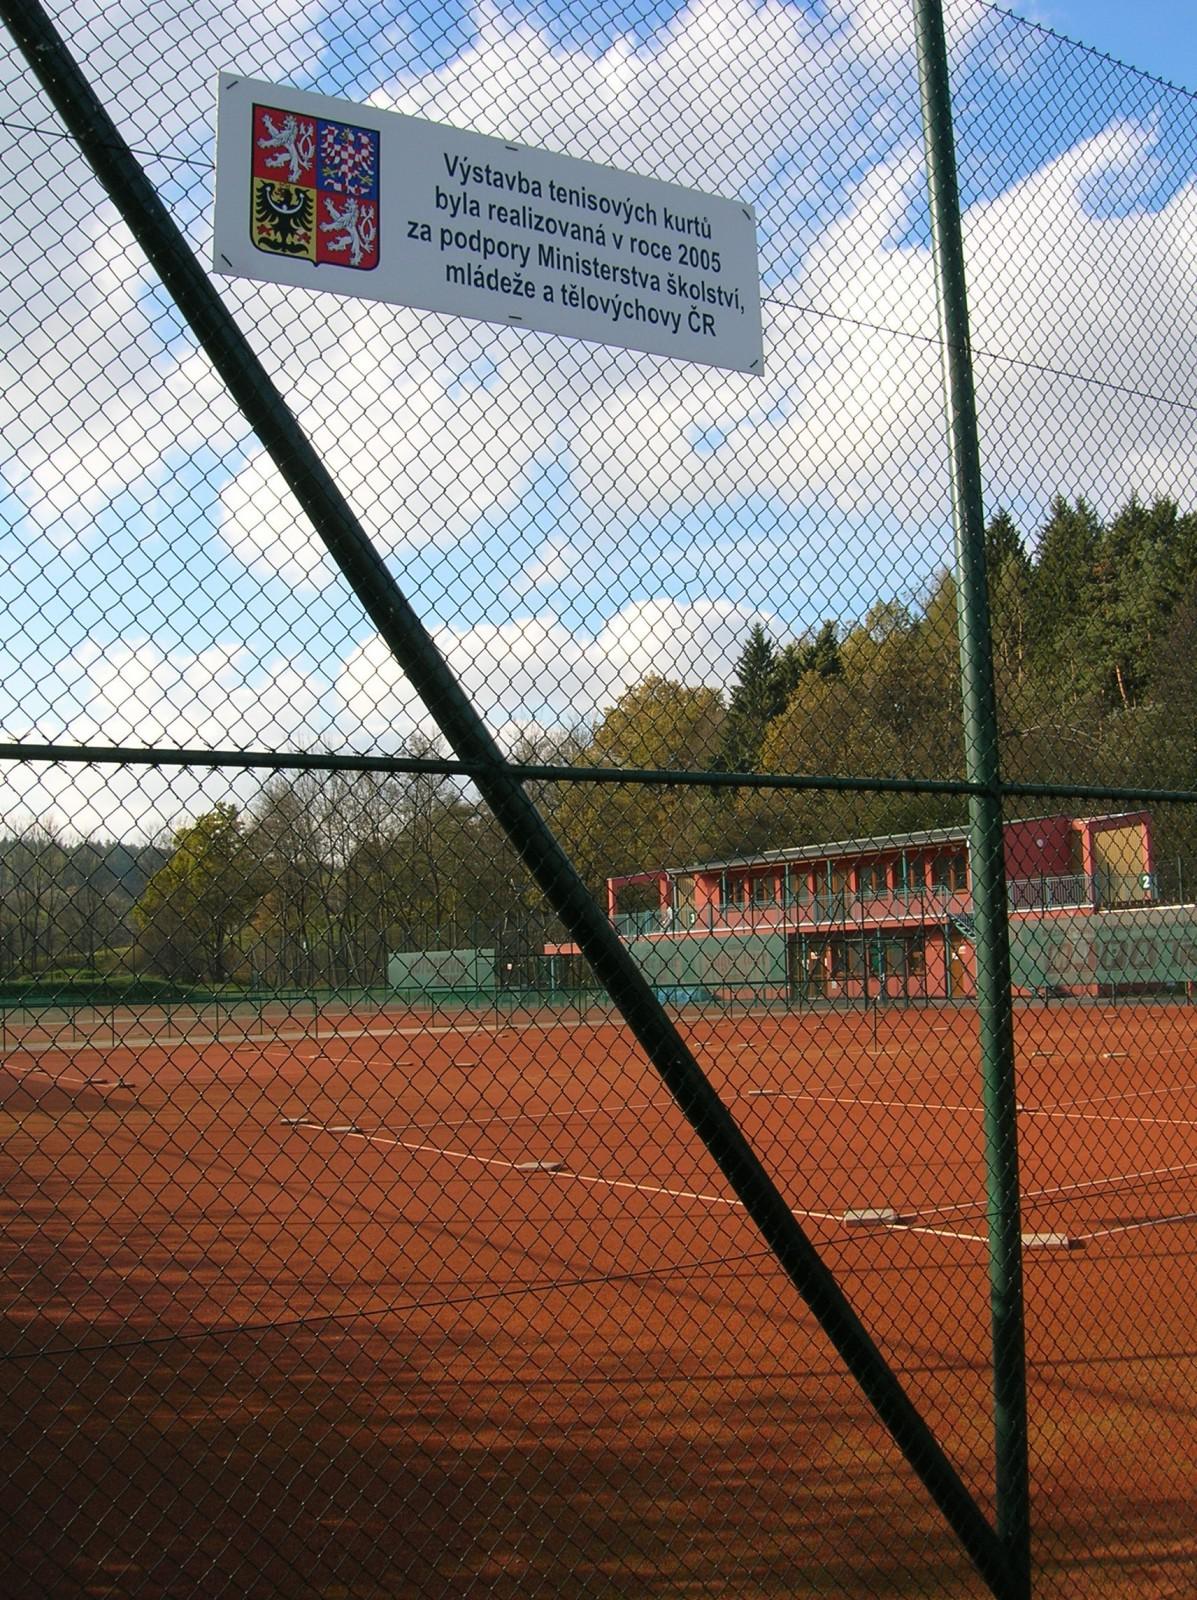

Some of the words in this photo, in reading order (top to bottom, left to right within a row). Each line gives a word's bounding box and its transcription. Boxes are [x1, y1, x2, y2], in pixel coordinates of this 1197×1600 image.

[435, 185, 481, 219] byla
[487, 202, 607, 248] realizovaná
[611, 231, 624, 251] v
[629, 236, 673, 262] roce
[677, 243, 722, 274] 2005
[444, 151, 543, 199] Výstavba
[547, 179, 658, 227] tenisových
[663, 206, 712, 240] kurtů
[406, 220, 433, 243] za
[439, 227, 531, 269] podpory
[537, 242, 661, 293] Ministerstva
[666, 271, 745, 315] školství,
[445, 262, 536, 300] mládeže
[542, 284, 555, 304] a
[560, 283, 682, 335] tělovýchovy
[687, 304, 717, 337] ČR
[1142, 875, 1151, 889] 2
